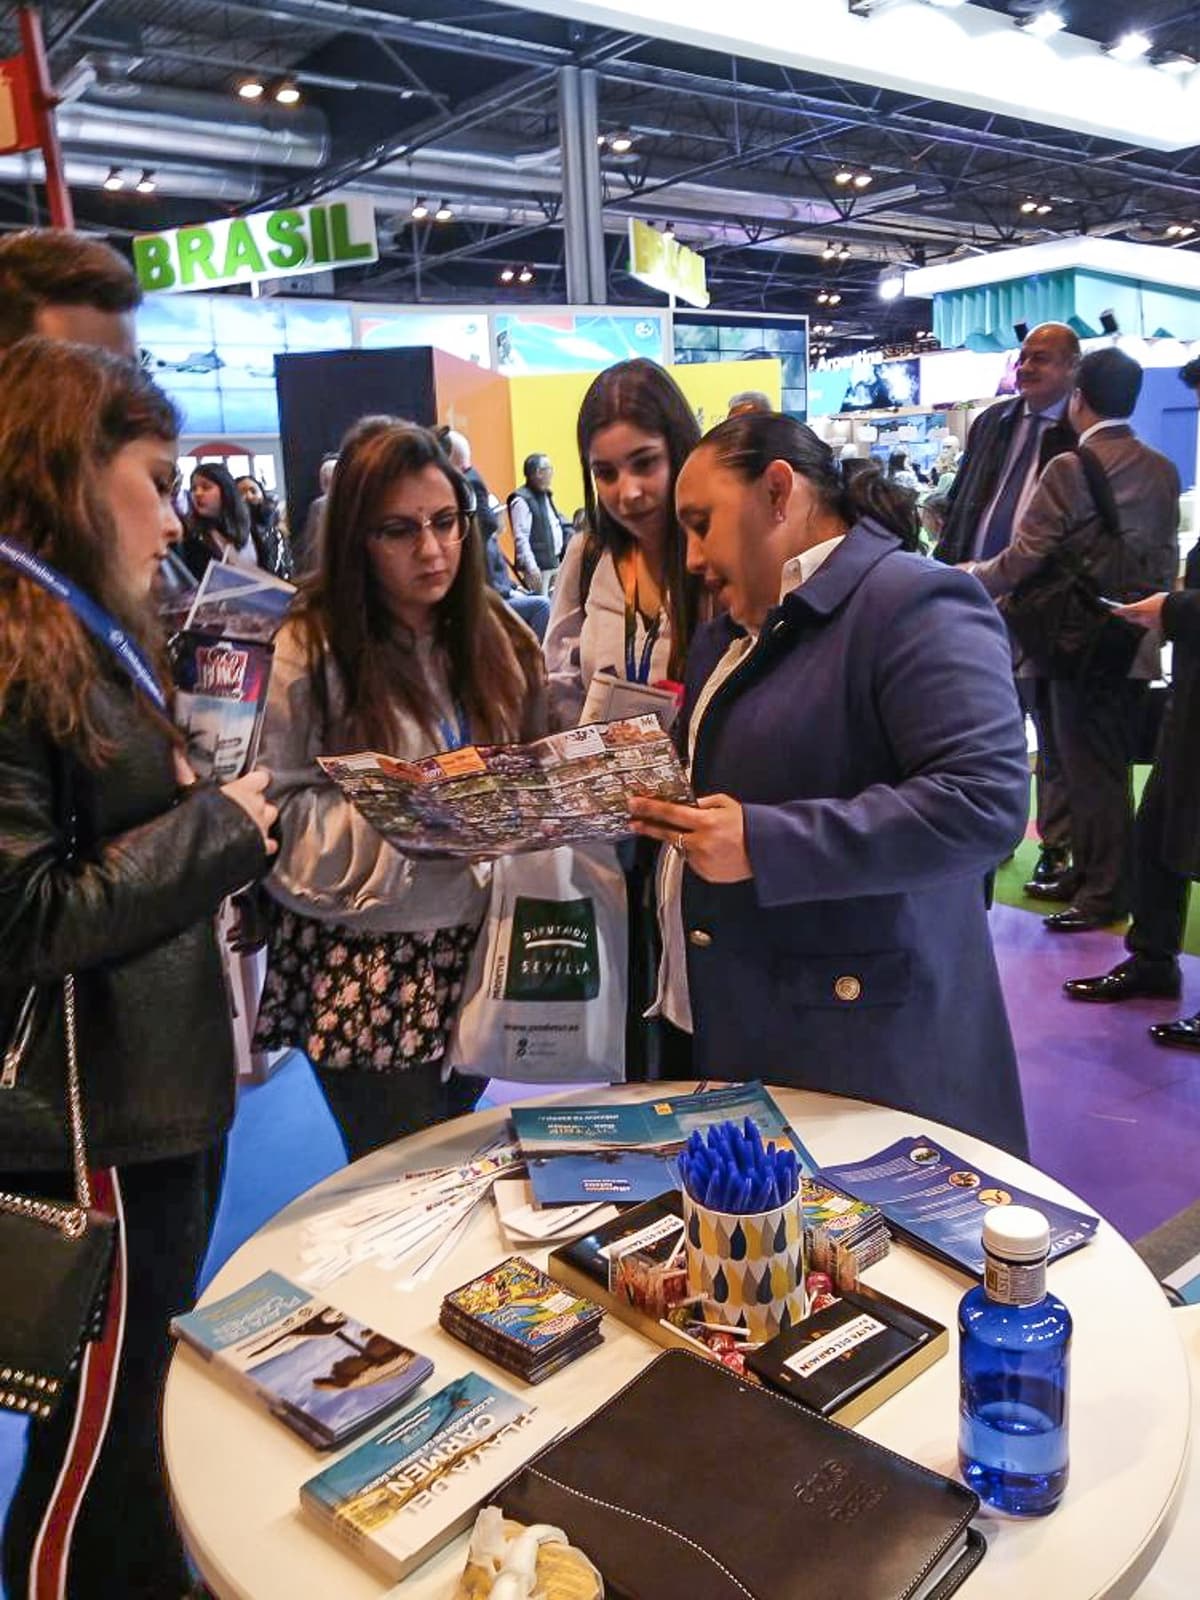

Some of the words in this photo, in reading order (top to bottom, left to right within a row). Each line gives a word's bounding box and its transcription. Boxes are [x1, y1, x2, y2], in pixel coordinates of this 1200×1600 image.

[133, 203, 373, 290] BRASIL
[520, 959, 592, 977] SEVILLA
[799, 1346, 837, 1373] CARMEN
[386, 1413, 496, 1501] CARMEN
[451, 1413, 532, 1477] PLAYA
[405, 1477, 449, 1516] DEL
